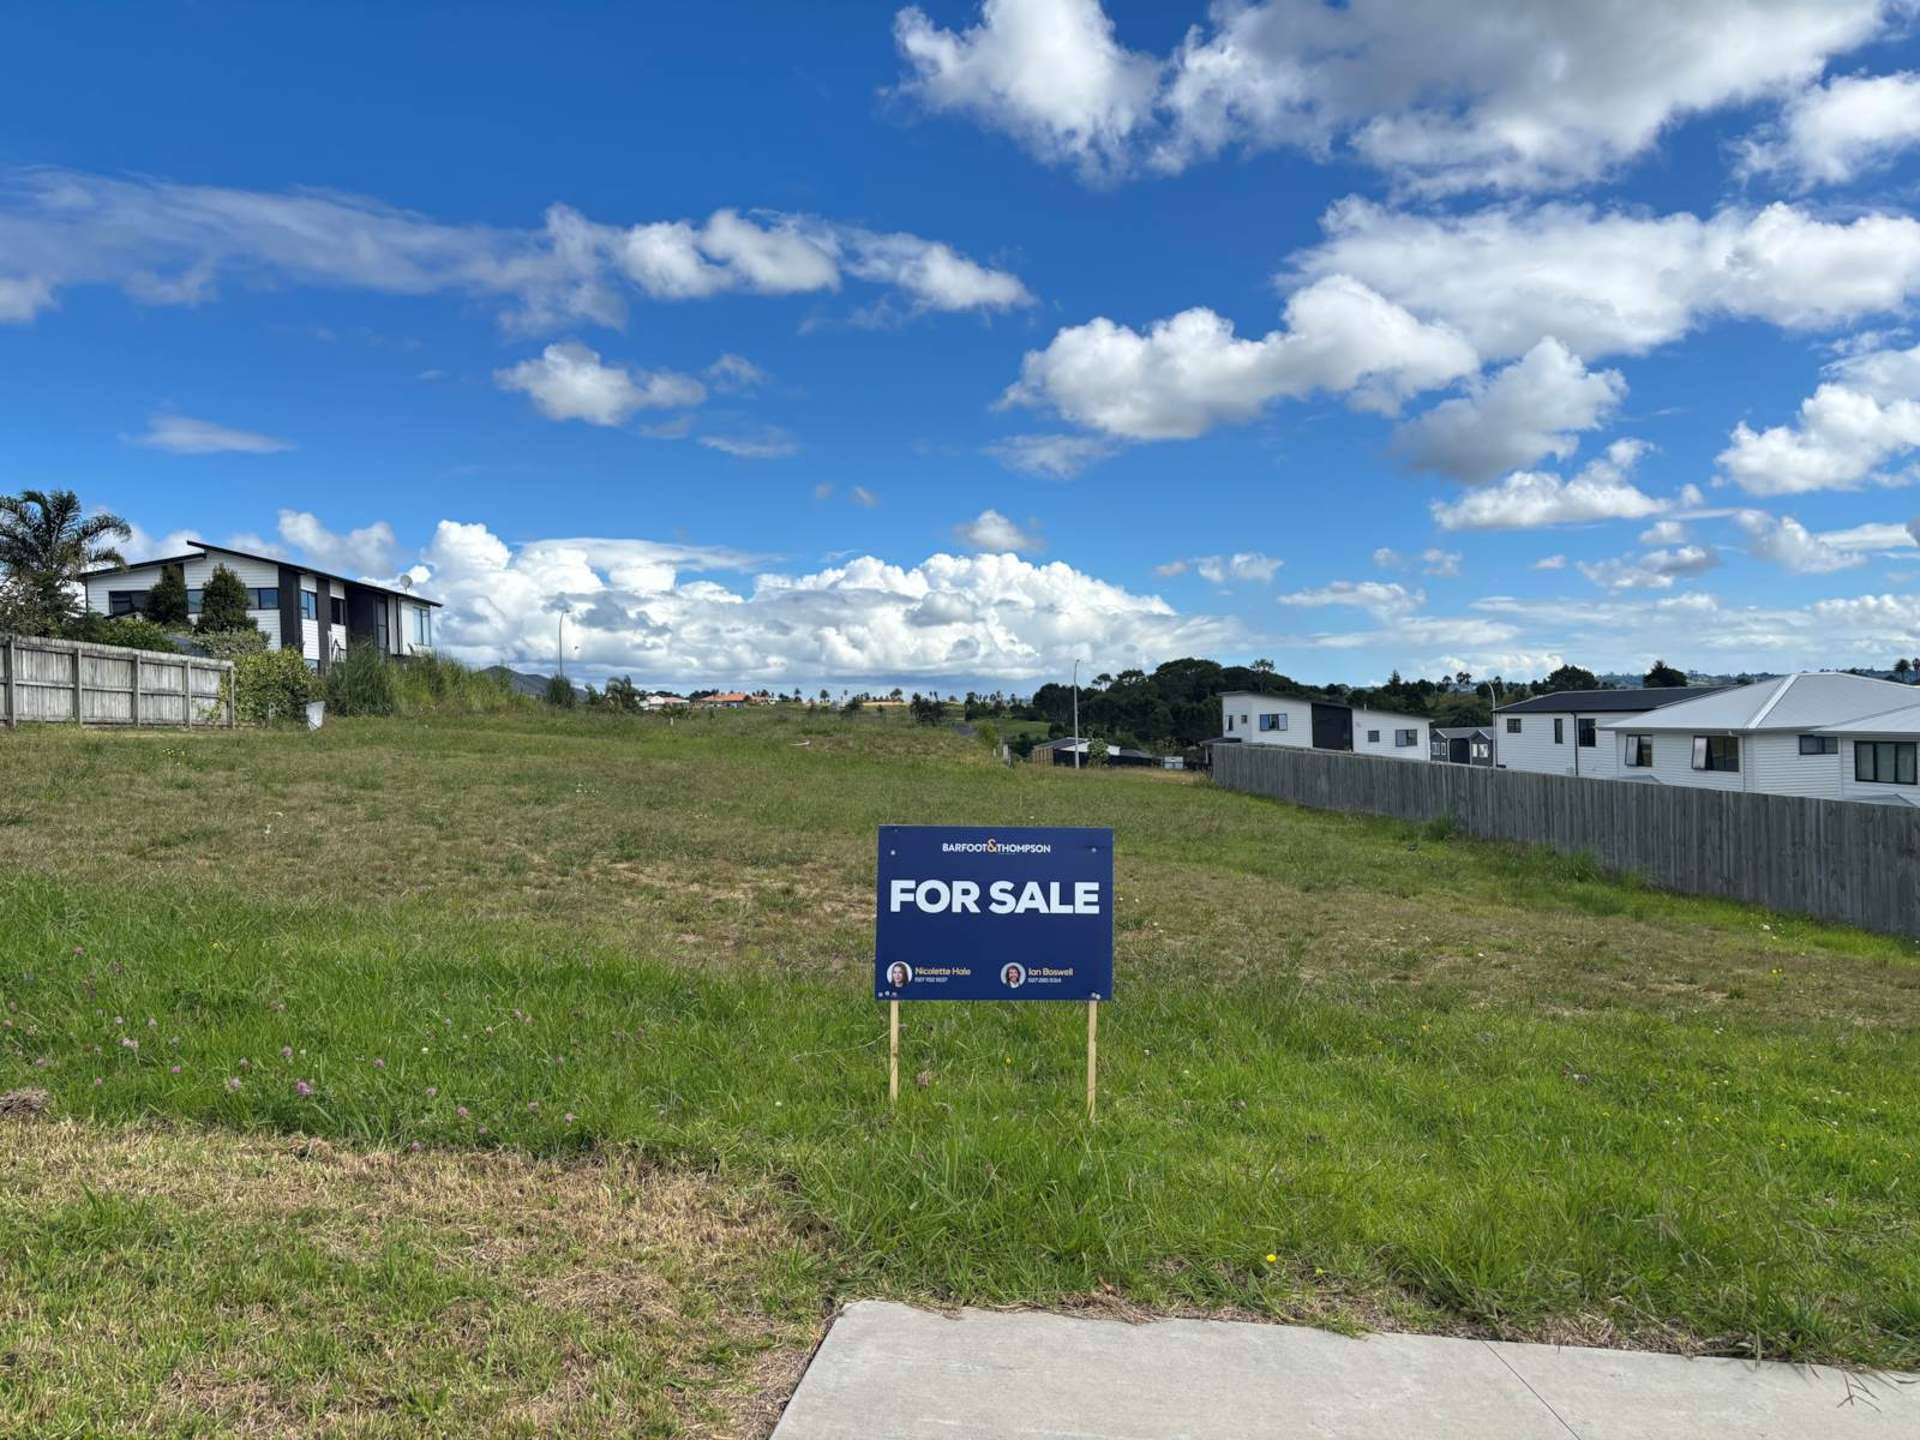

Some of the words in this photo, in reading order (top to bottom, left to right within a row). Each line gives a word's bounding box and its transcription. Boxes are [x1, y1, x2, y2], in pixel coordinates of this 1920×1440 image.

[890, 880, 981, 913] FOR
[988, 881, 1100, 914] SALE
[1028, 968, 1041, 976] Ian
